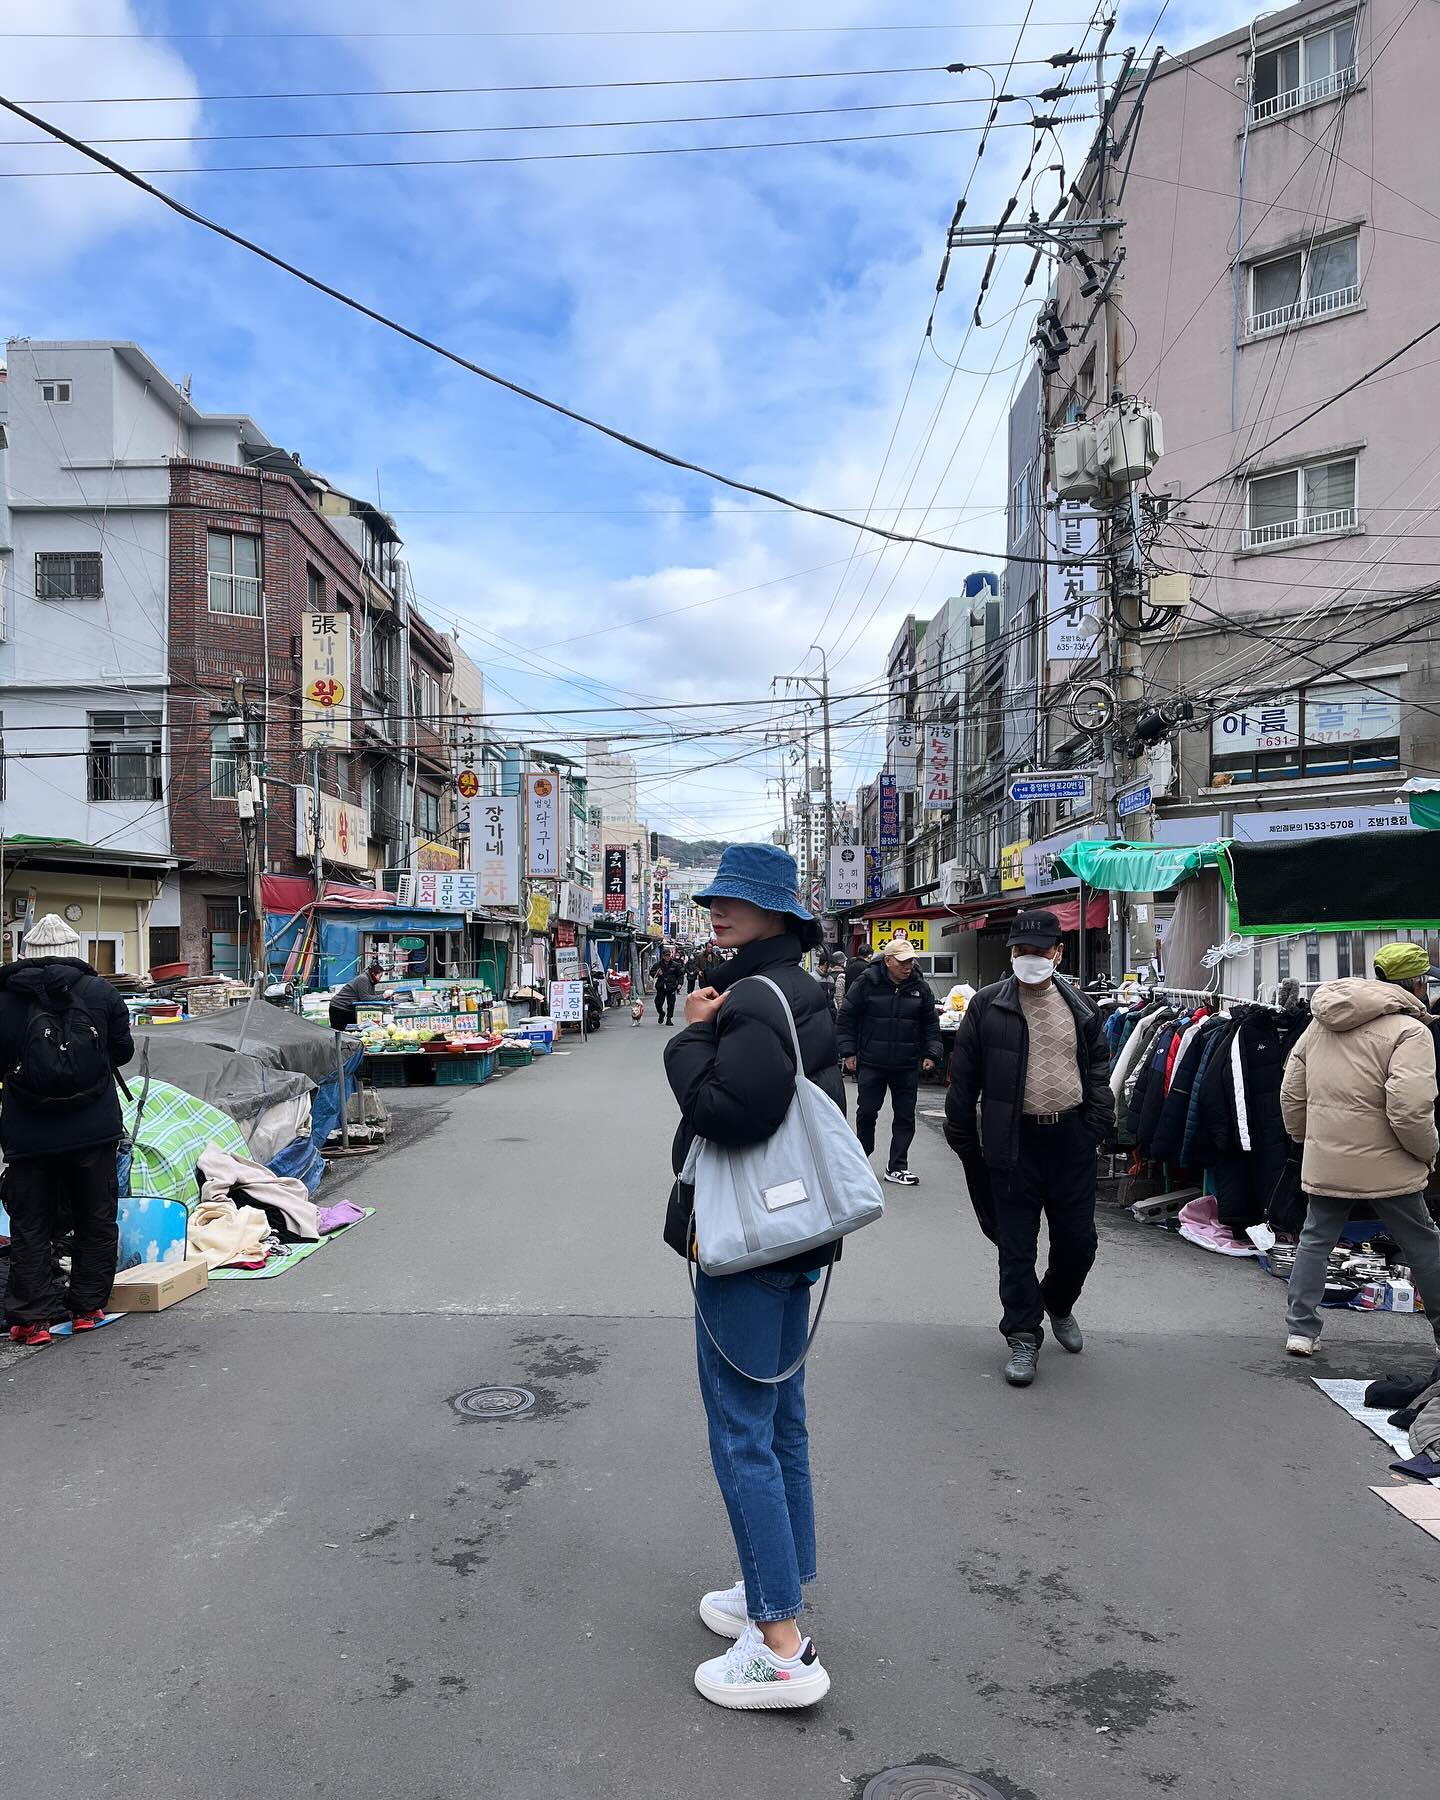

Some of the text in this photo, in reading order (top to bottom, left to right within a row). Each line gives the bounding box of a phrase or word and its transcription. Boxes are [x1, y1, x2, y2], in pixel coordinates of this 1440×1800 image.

[1304, 820, 1354, 832] 1533-5708
[1367, 816, 1408, 828] 조방1호점
[420, 875, 477, 906] 열쇠 고무인 도장
[567, 983, 581, 1009] 도장
